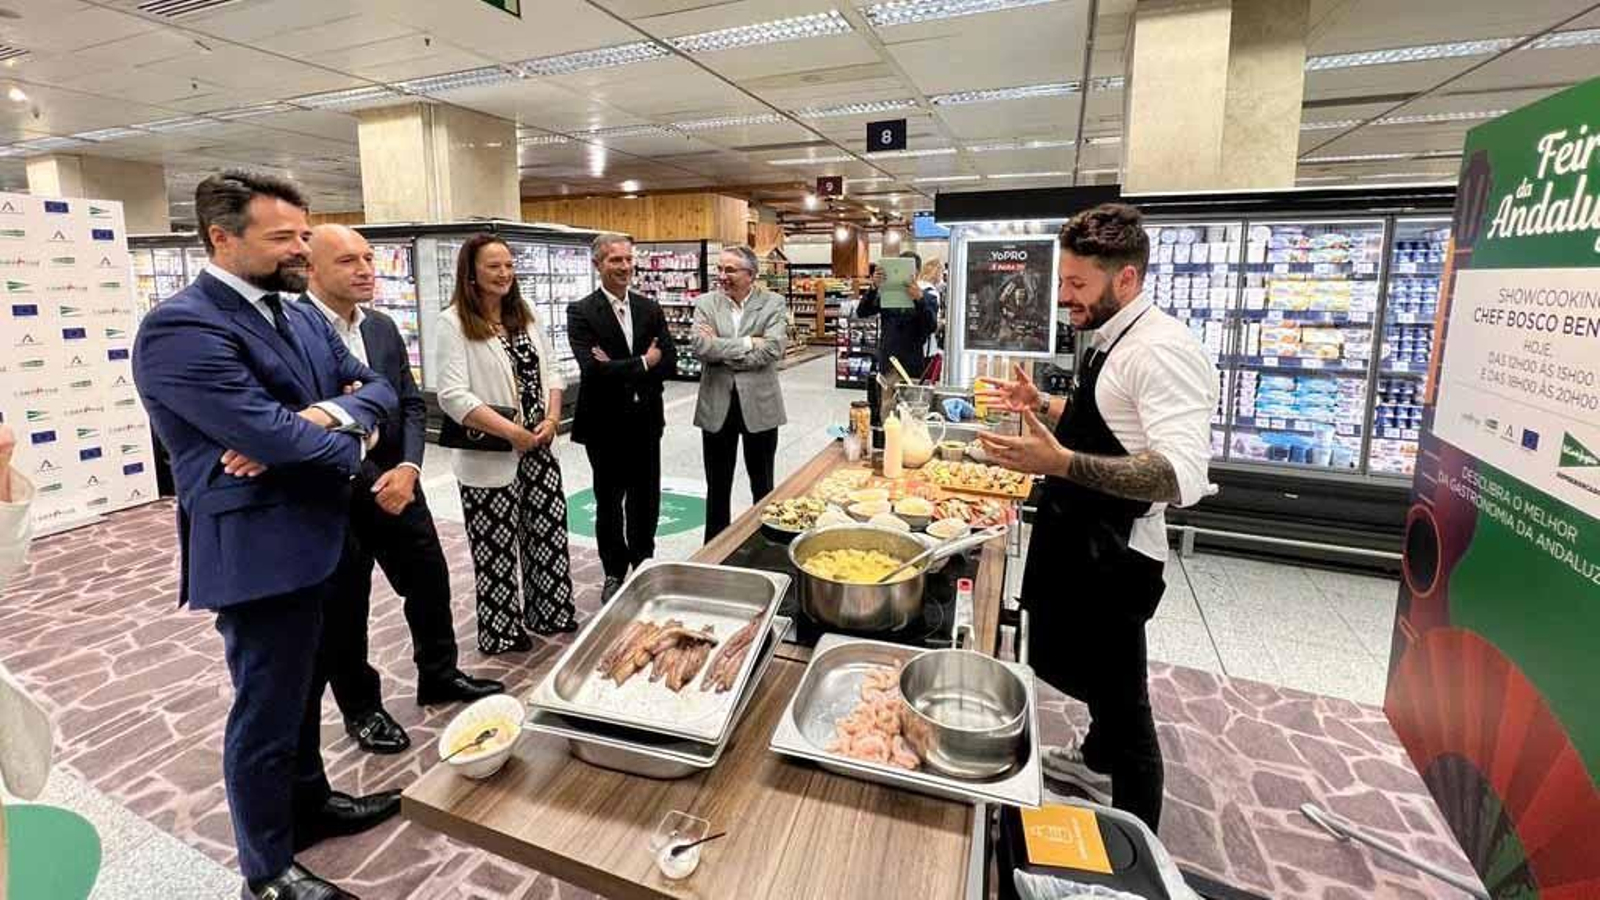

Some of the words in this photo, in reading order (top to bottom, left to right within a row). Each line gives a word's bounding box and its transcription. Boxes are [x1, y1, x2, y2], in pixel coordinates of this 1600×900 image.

[881, 129, 892, 144] 8
[825, 182, 833, 191] 9
[1516, 177, 1534, 199] da
[1487, 174, 1600, 239] Andalu
[991, 251, 1028, 261] YoPRO
[1499, 288, 1600, 309] SHOWCOOKIN
[1474, 307, 1505, 325] CHEF
[1507, 310, 1559, 332] BOSCO
[1557, 366, 1595, 387] 15H00
[1556, 386, 1599, 410] 20H00
[1449, 478, 1515, 530] GASTRONOMIA
[1516, 520, 1534, 542] DA
[1462, 466, 1511, 506] DESCUBRA
[1513, 496, 1523, 510] O
[1524, 501, 1578, 544] MELHOR
